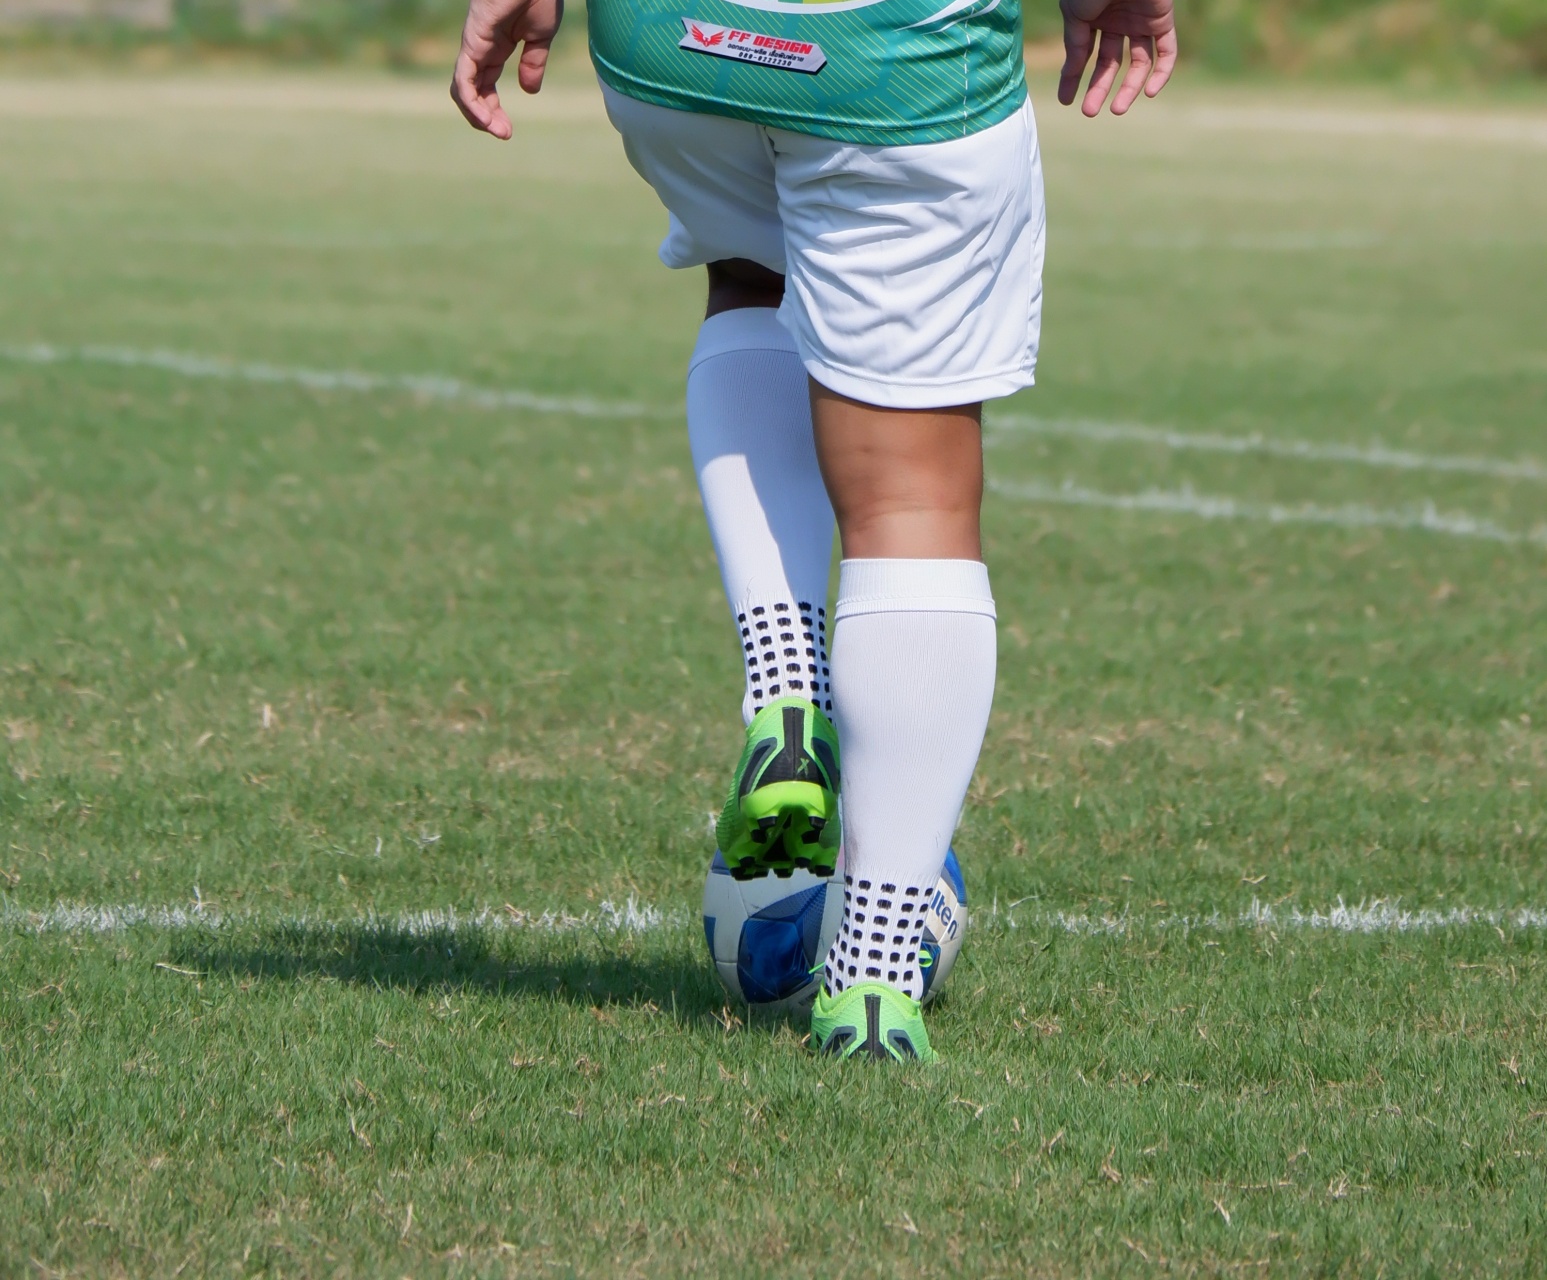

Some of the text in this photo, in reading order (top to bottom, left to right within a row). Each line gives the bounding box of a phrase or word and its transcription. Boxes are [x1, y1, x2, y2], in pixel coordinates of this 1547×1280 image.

[729, 31, 813, 54] FF DESIGN
[930, 889, 958, 941] lten
